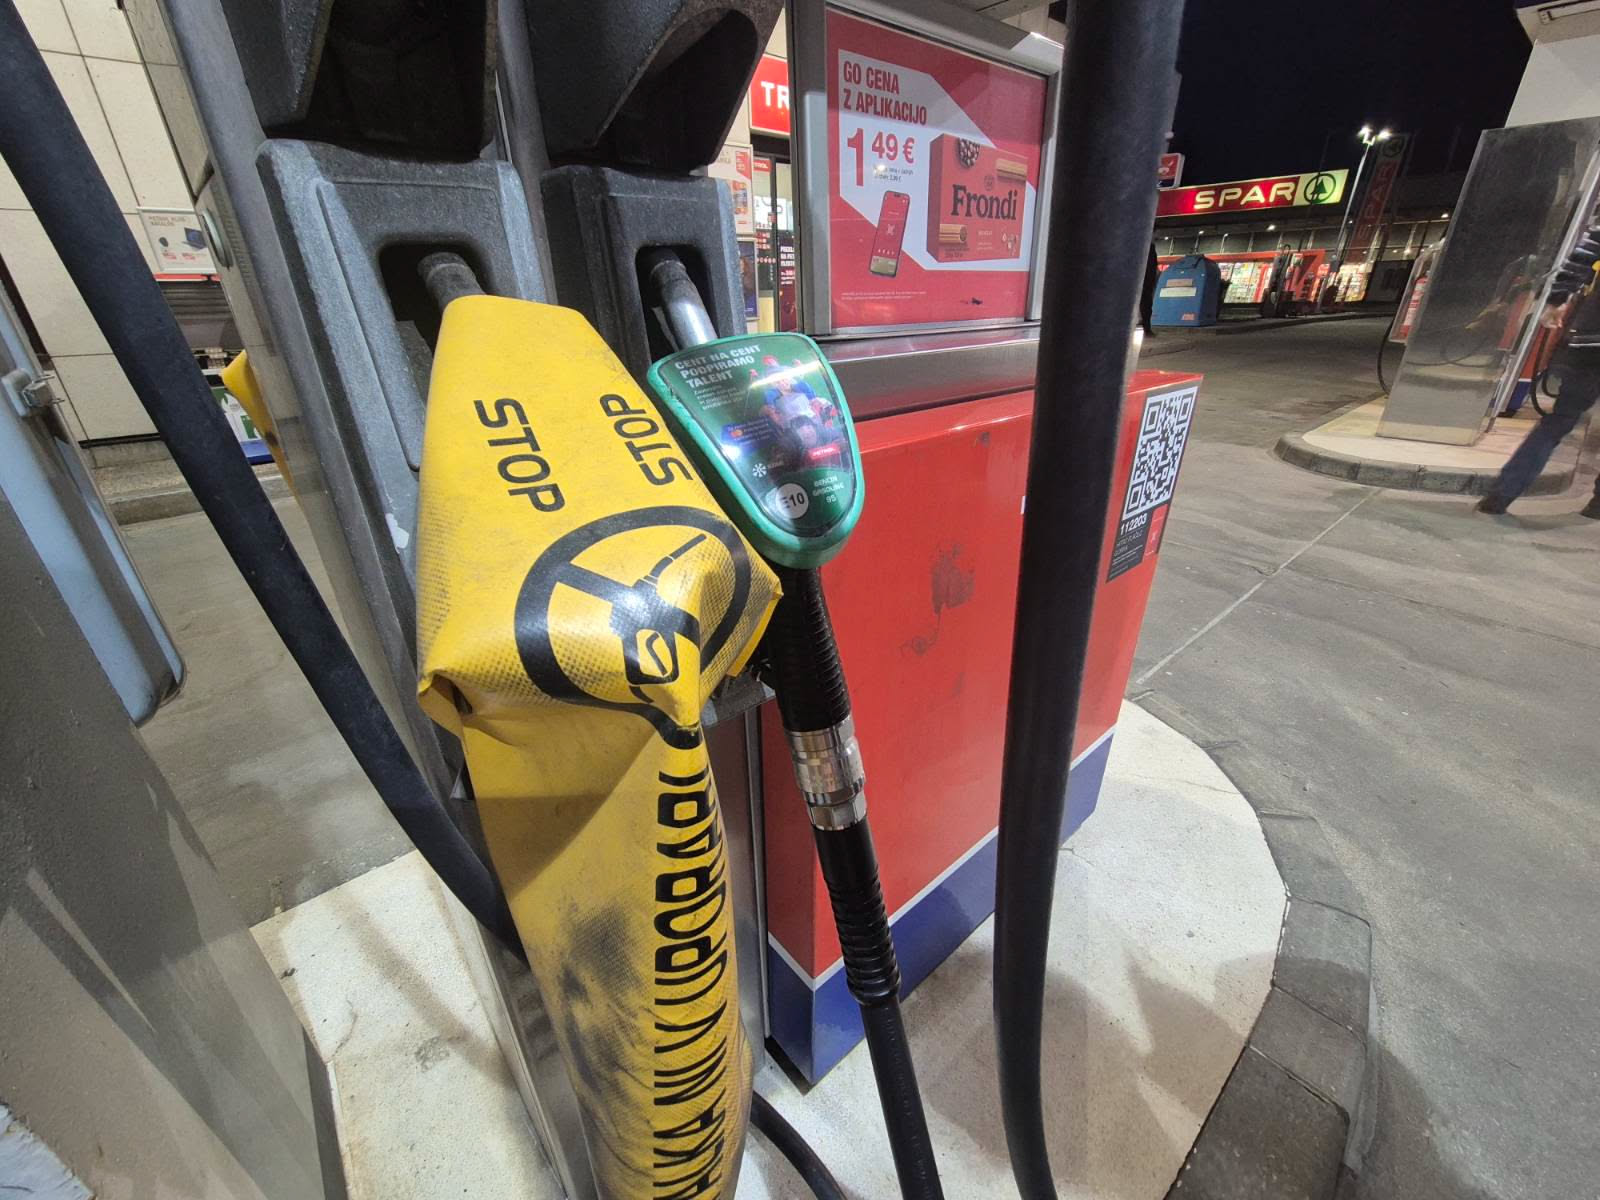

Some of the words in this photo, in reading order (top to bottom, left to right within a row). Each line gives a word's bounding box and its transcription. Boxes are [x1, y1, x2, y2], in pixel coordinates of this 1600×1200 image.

[843, 60, 861, 85] GO
[866, 66, 899, 95] CENA
[843, 88, 852, 111] Z
[856, 91, 927, 126] APLIKACIJO
[847, 127, 864, 187] 1
[871, 131, 899, 161] 49
[903, 136, 915, 164] €
[951, 183, 1019, 220] Frondi
[1193, 182, 1296, 210] SPAR
[730, 344, 760, 358] CENT
[686, 370, 733, 389] TALENT
[473, 397, 566, 513] STOP
[600, 393, 694, 487] STOP
[653, 764, 728, 1006] UPORABI
